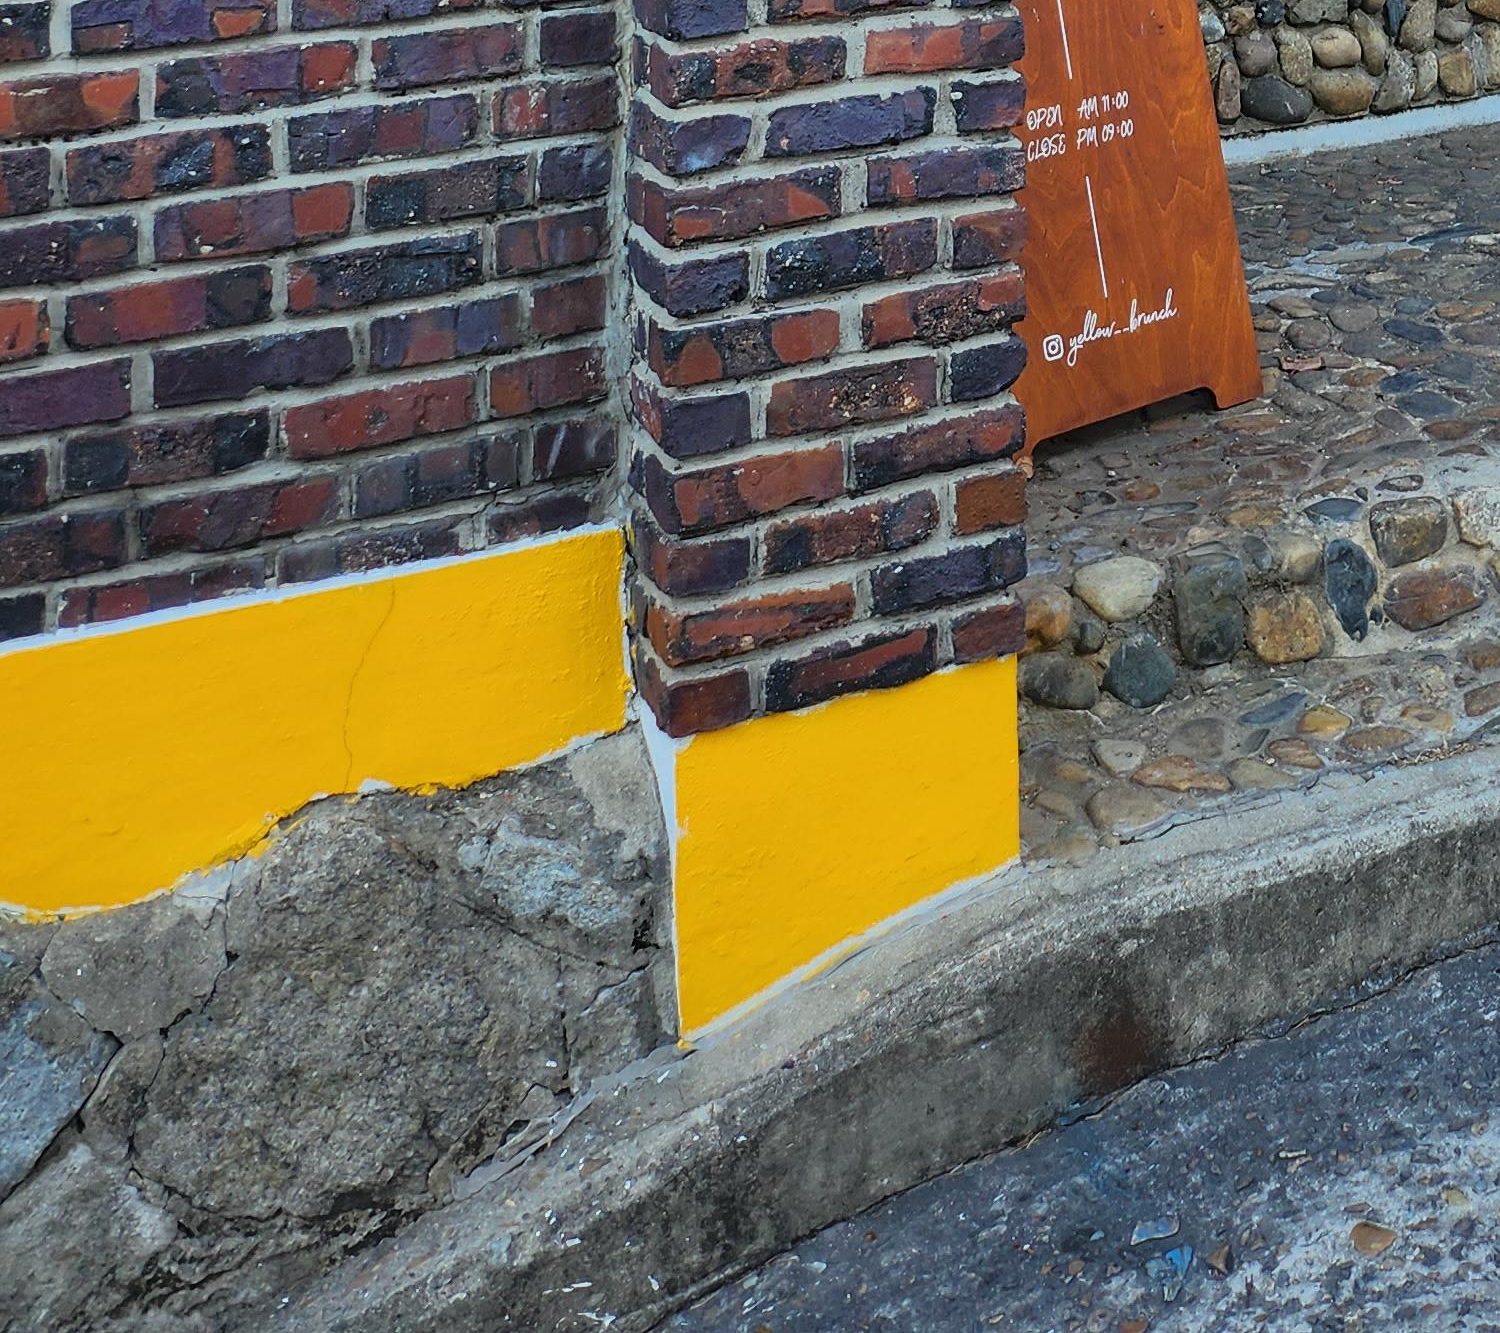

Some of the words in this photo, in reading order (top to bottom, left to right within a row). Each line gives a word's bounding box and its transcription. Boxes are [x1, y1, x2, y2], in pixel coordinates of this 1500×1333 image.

[1026, 103, 1064, 131] OPEN
[1076, 95, 1099, 120] AM
[1101, 90, 1129, 113] 11:00
[1027, 133, 1067, 162] CLOSE
[1076, 125, 1099, 150] PM
[1101, 118, 1134, 143] 09:00
